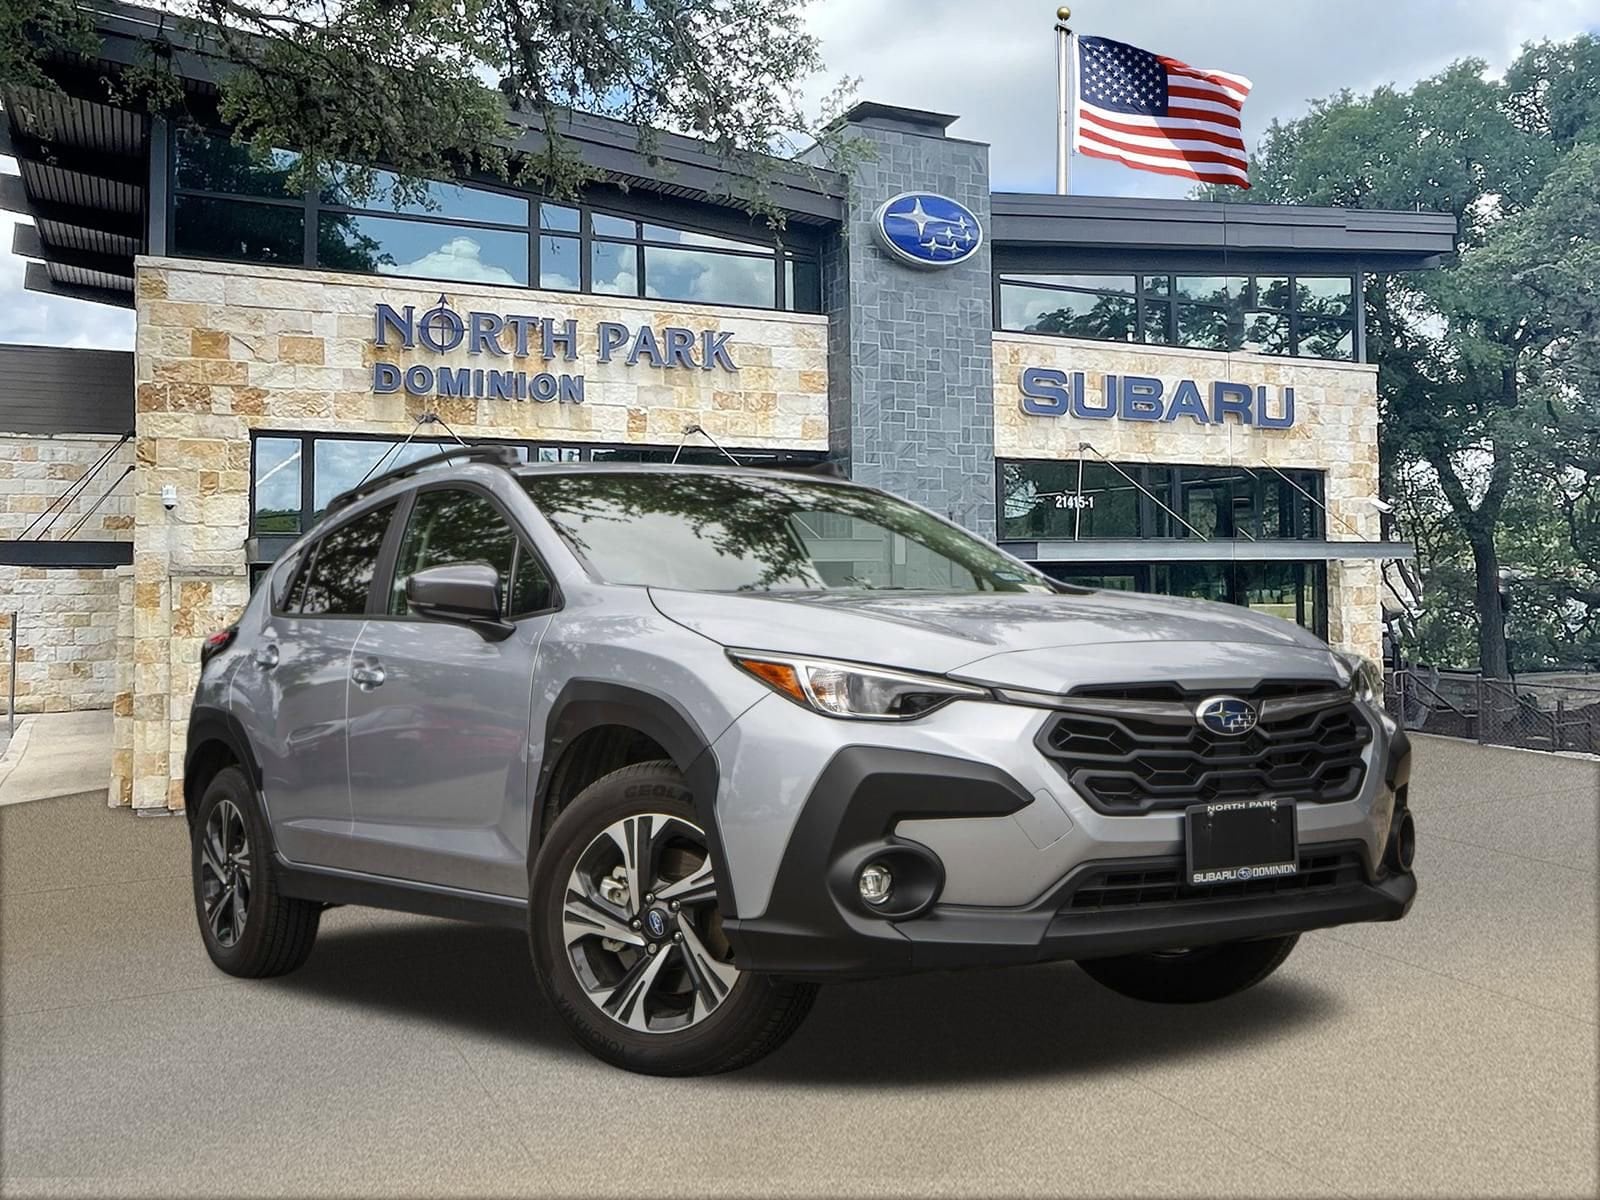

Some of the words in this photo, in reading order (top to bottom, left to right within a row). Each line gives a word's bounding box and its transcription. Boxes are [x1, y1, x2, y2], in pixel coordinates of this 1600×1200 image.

[375, 302, 578, 361] NORTH
[597, 321, 741, 373] PARK
[373, 362, 585, 404] DOMINION
[1020, 367, 1295, 429] SUBARU
[1207, 803, 1246, 812] NORTH
[1249, 800, 1278, 809] PARK
[1193, 870, 1237, 883] SUBARU
[1252, 863, 1297, 877] DOMINION
